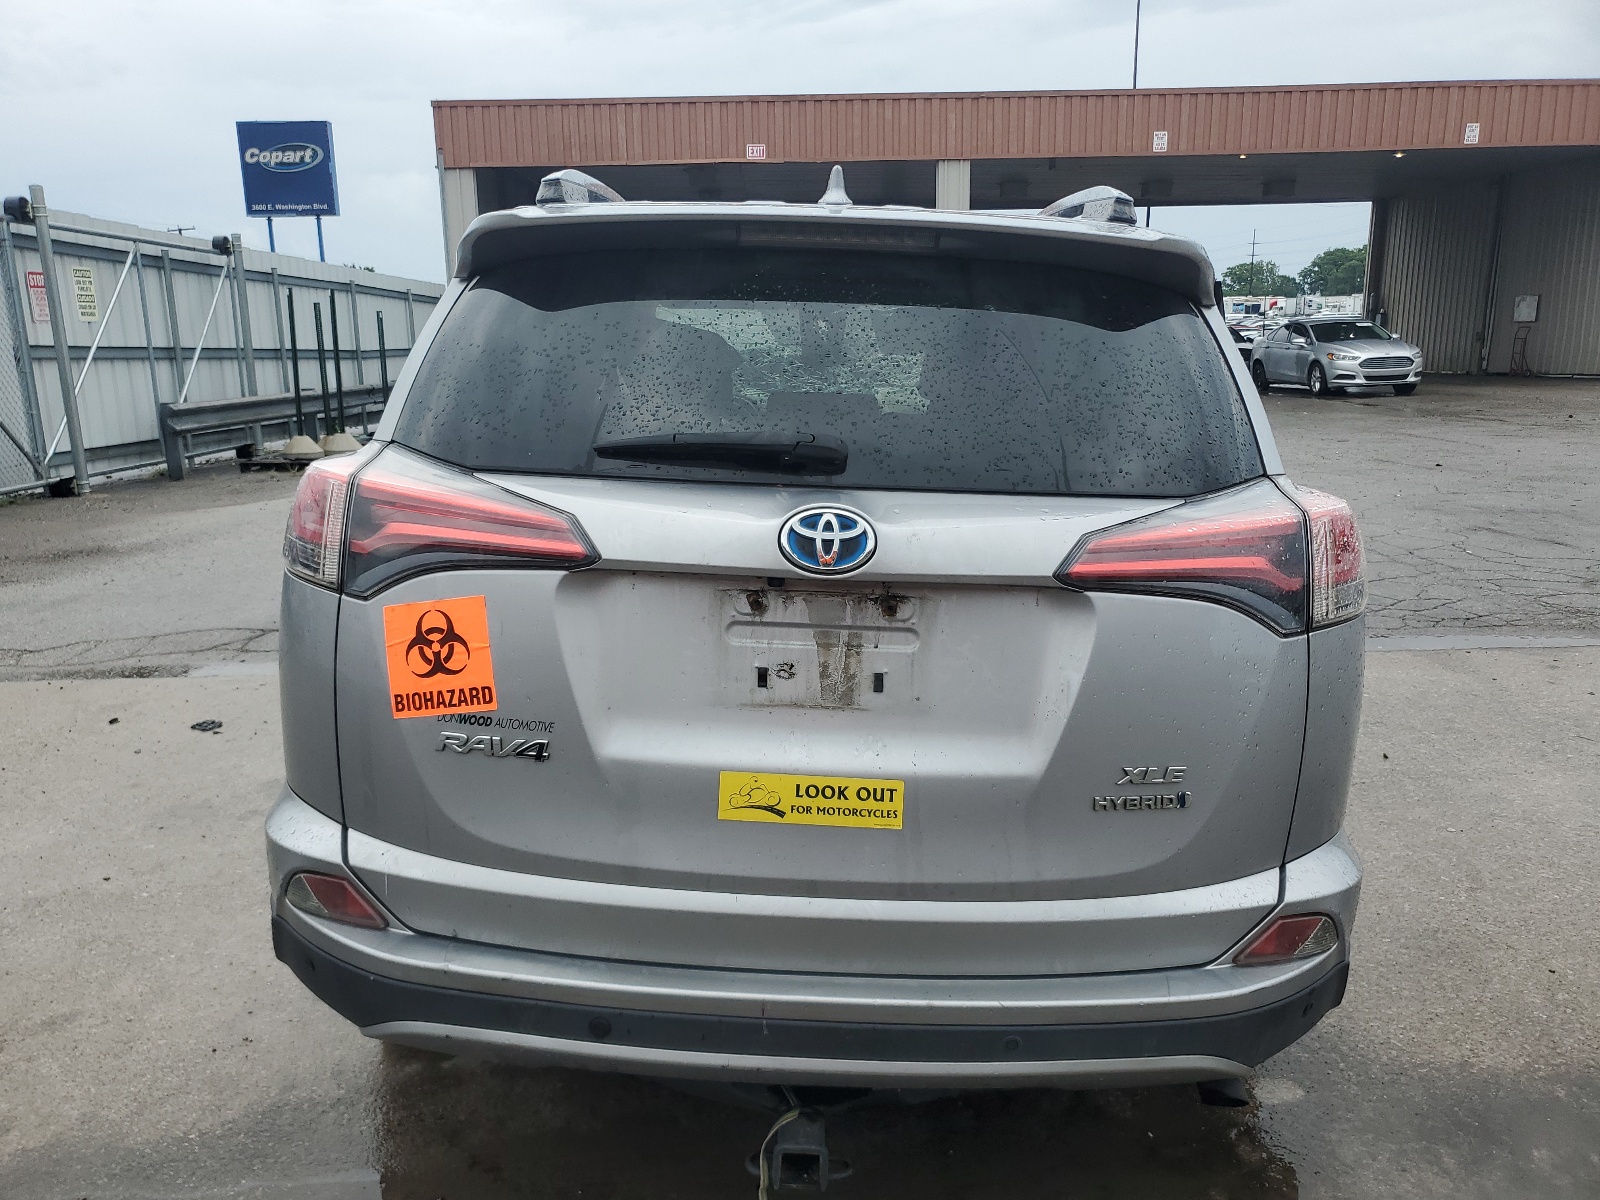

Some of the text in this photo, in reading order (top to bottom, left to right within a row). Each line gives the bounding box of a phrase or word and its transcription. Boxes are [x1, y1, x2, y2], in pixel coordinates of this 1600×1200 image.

[244, 147, 314, 167] Copart
[748, 146, 764, 157] EXIT
[275, 203, 312, 212] Washington
[394, 685, 494, 713] BIOHAZARD
[494, 717, 555, 733] AUTOMOTIVE
[436, 731, 550, 763] RAV4
[1115, 766, 1188, 785] XLE
[795, 783, 898, 803] LOOK OUT
[790, 804, 898, 819] FOR MOTORCYCLES
[1093, 794, 1177, 811] HYBRID
